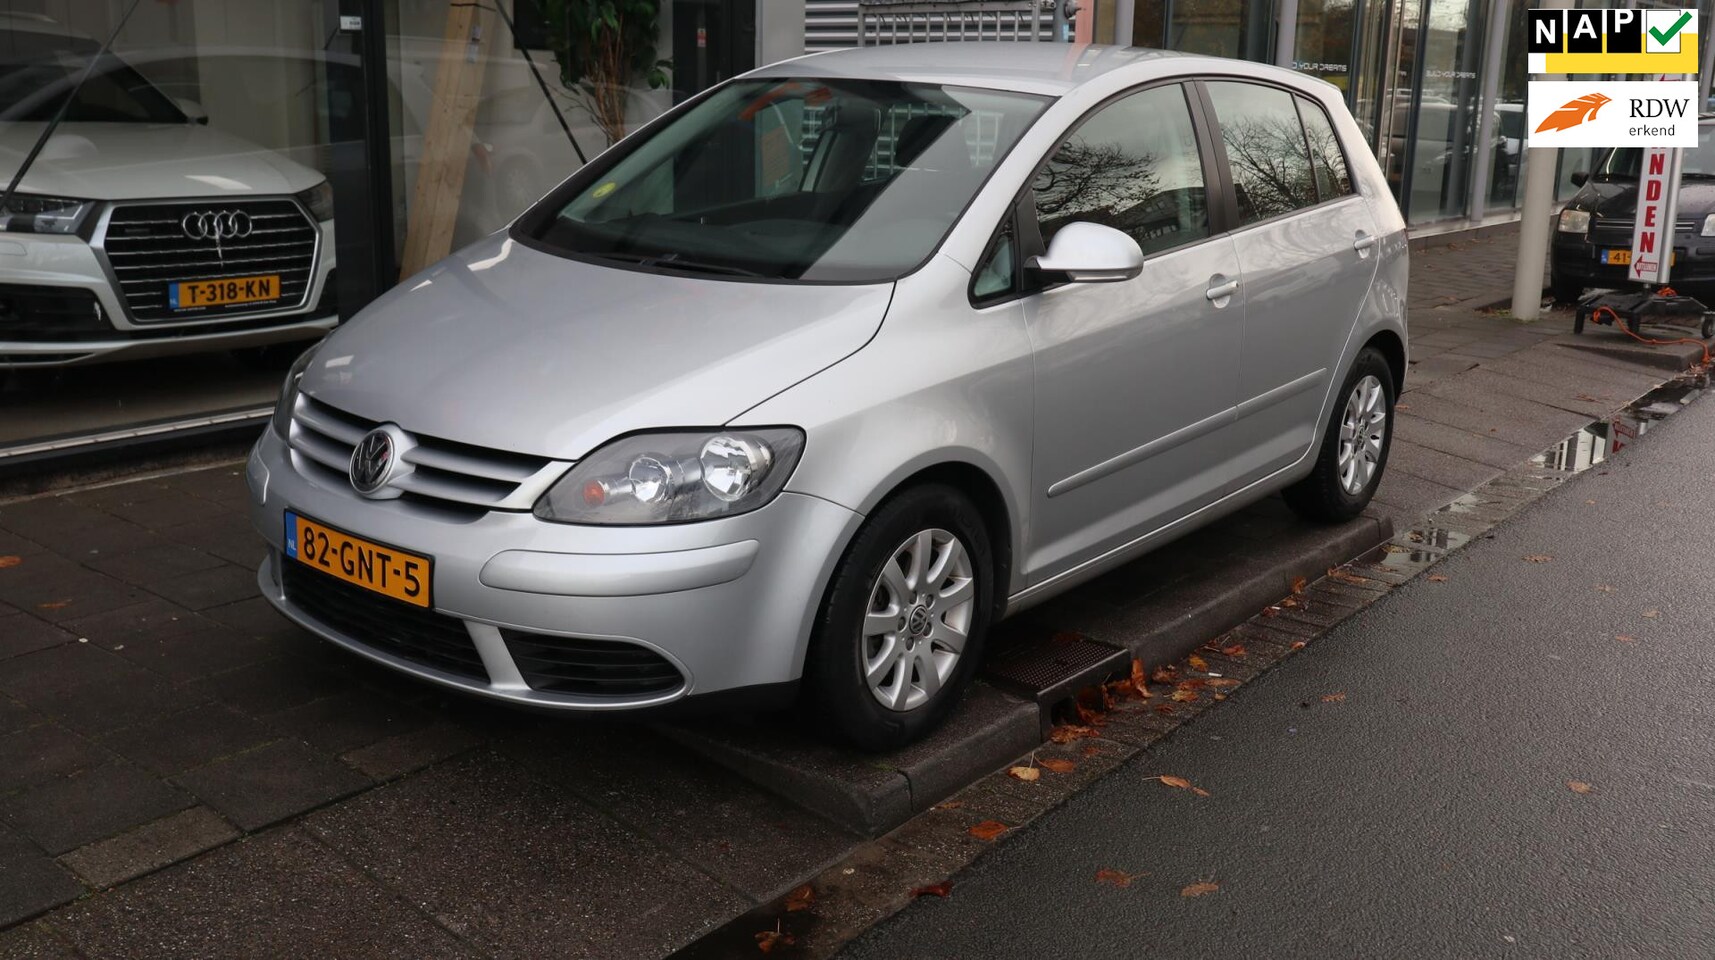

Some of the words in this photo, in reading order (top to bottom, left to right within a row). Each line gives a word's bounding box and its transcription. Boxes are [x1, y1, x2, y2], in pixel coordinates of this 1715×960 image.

[1640, 147, 1665, 253] NDEN
[187, 279, 271, 304] T-318-KN
[287, 538, 297, 551] NL
[303, 526, 421, 598] 82-GNT-5
